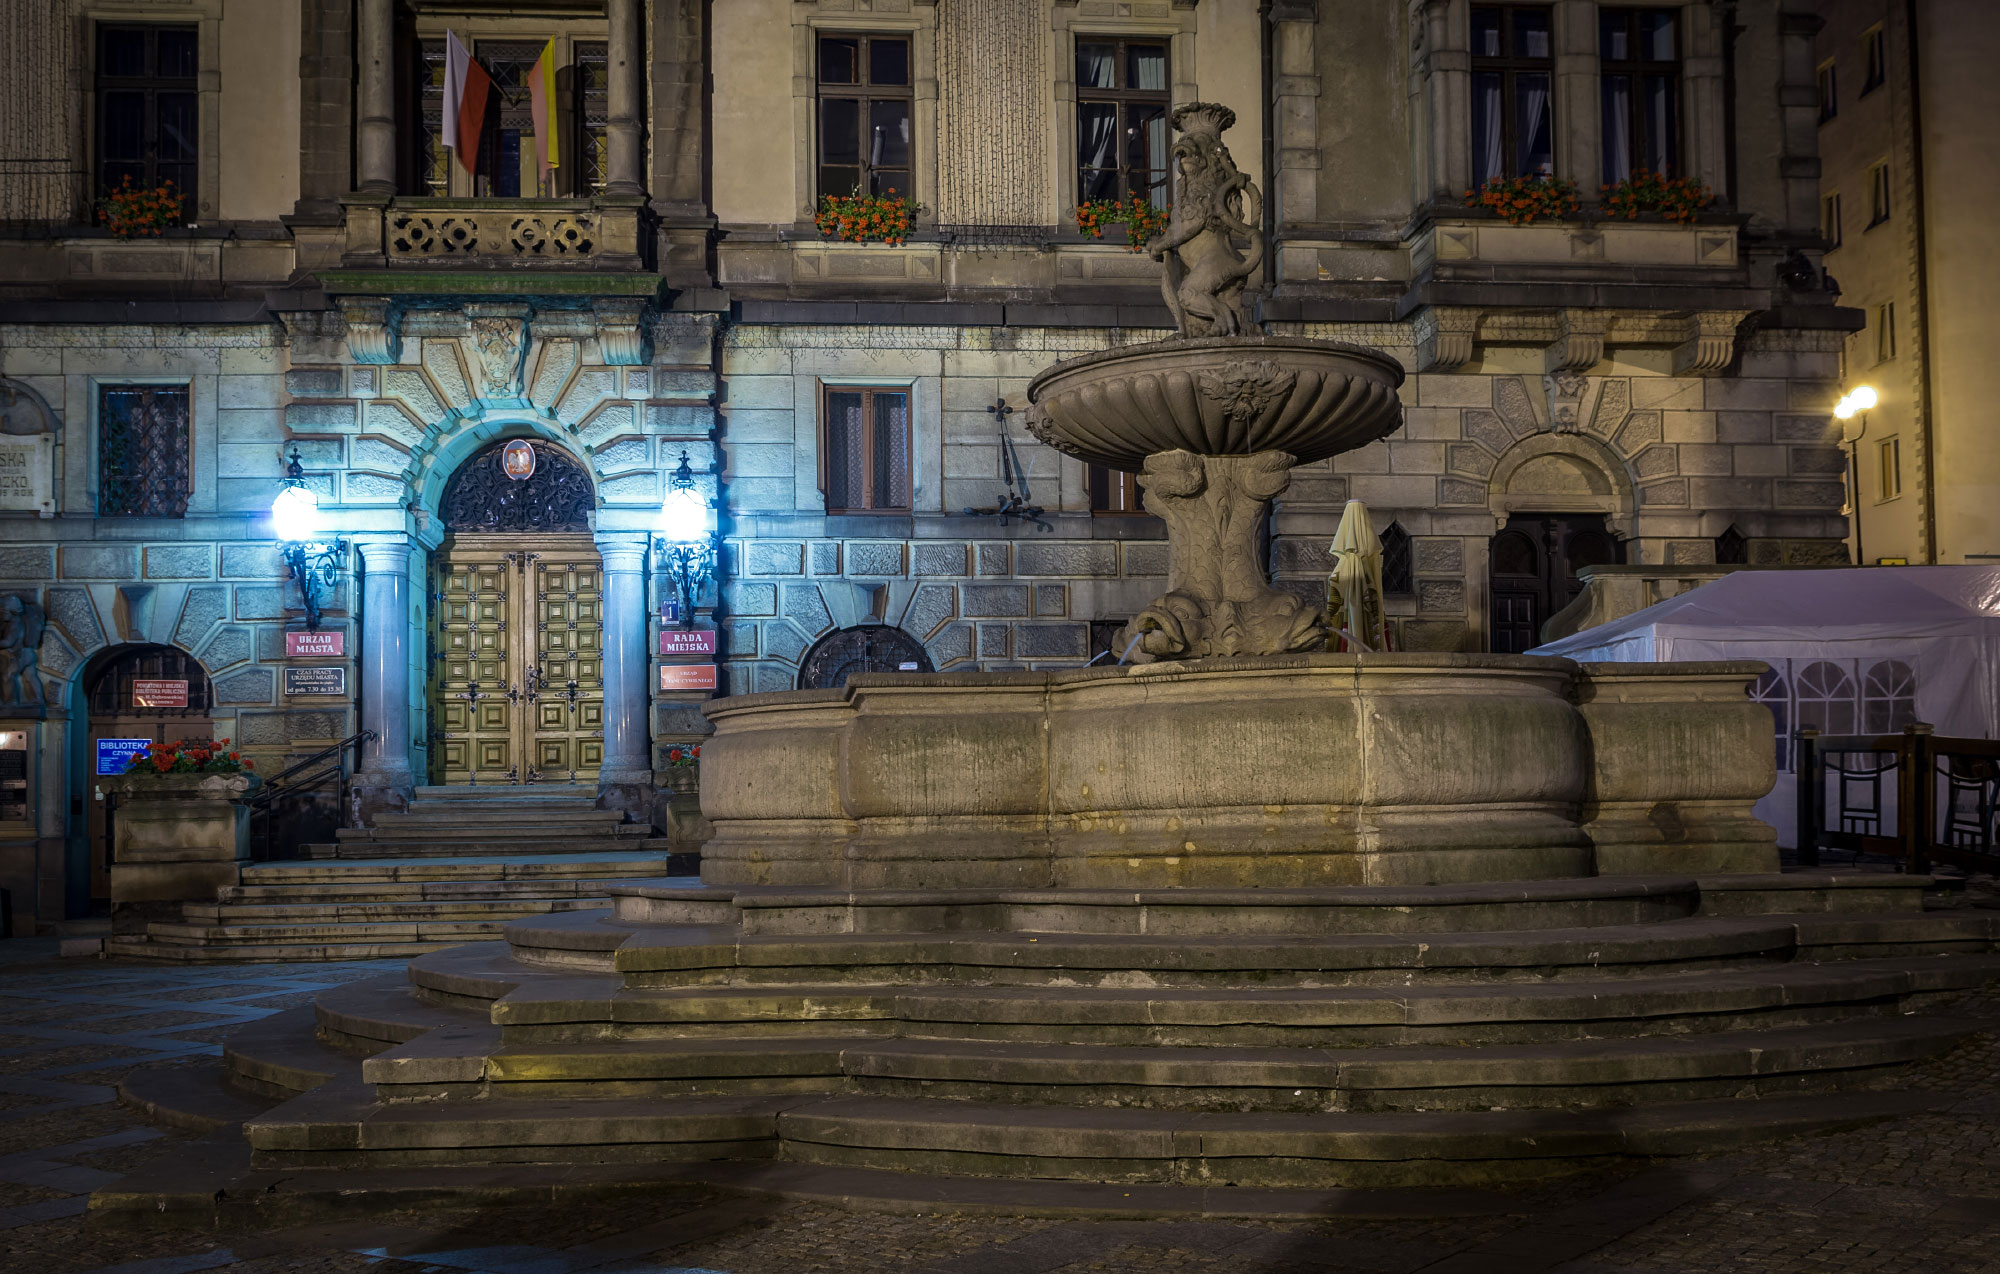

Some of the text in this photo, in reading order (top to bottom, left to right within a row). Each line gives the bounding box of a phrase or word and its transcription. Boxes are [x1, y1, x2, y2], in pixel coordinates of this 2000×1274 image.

[668, 606, 673, 619] 1
[674, 634, 703, 642] RADA
[296, 645, 334, 653] MIASTA
[667, 643, 710, 652] MIEJSKA
[100, 742, 149, 750] BIBLIOTEKA
